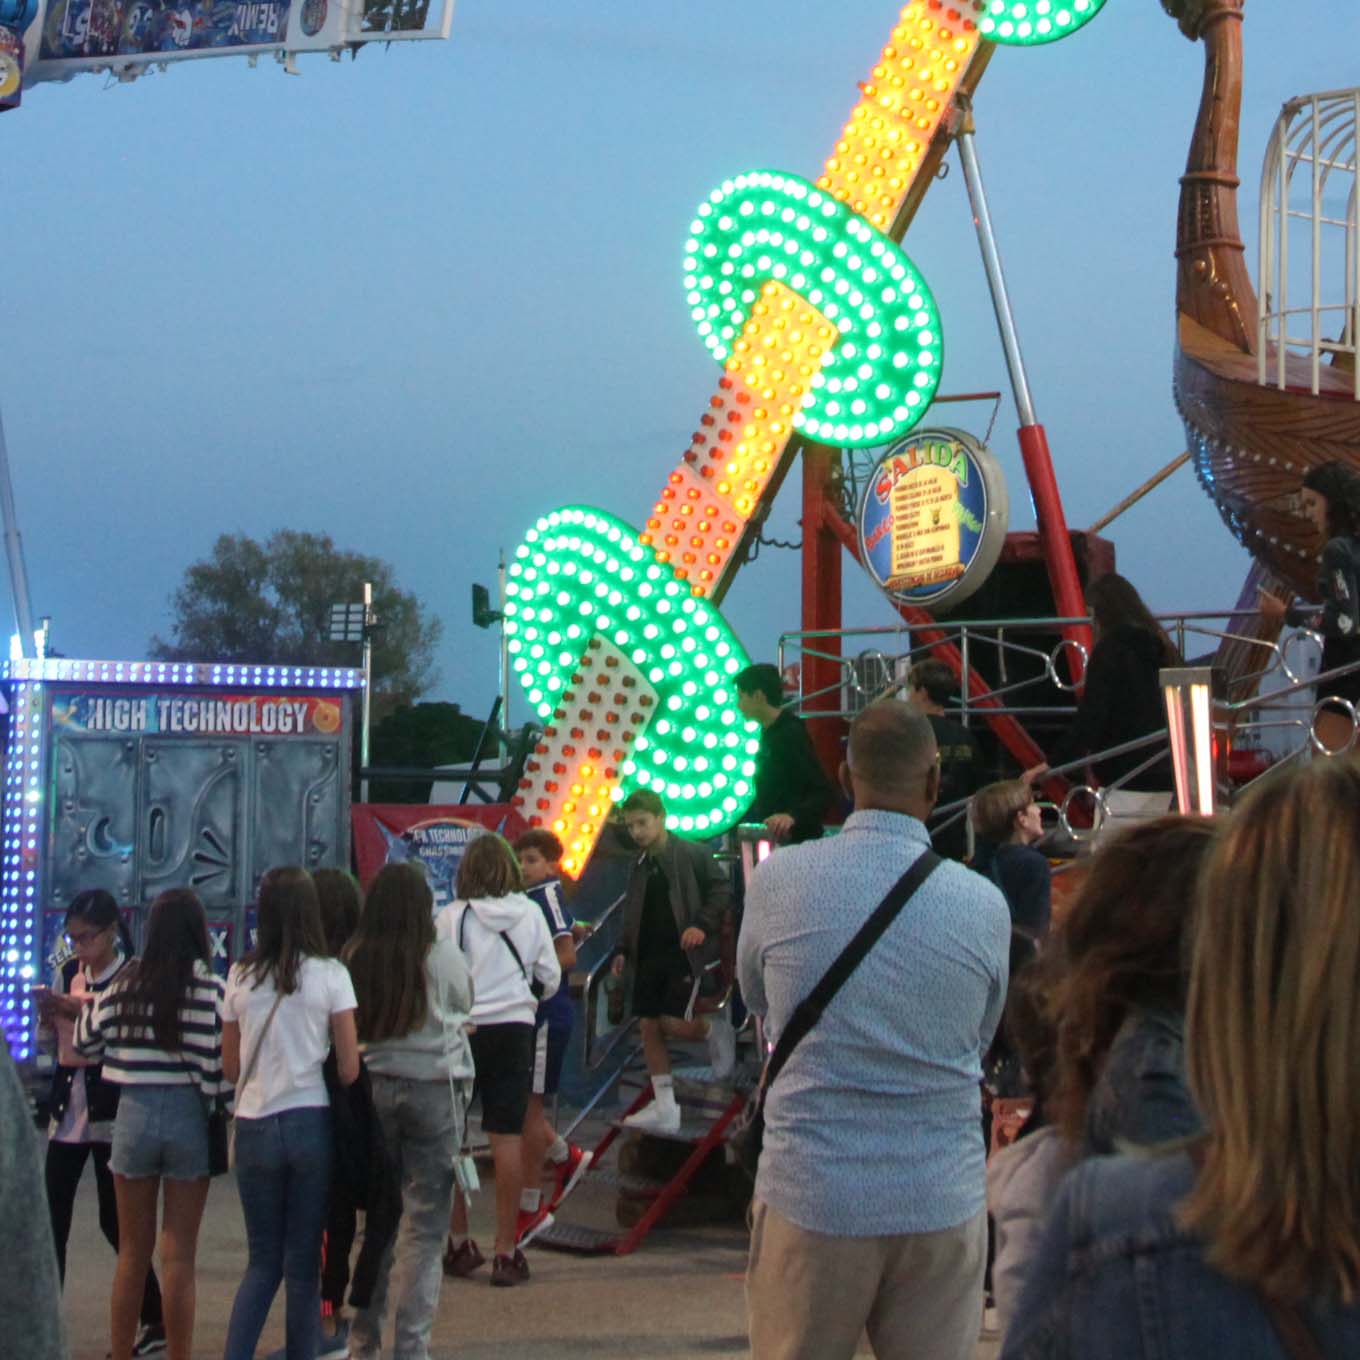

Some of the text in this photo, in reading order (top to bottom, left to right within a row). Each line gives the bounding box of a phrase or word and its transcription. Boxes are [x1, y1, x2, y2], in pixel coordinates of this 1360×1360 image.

[876, 441, 968, 503] SALIDA
[87, 697, 308, 734] HIGH TECHNOLOGY
